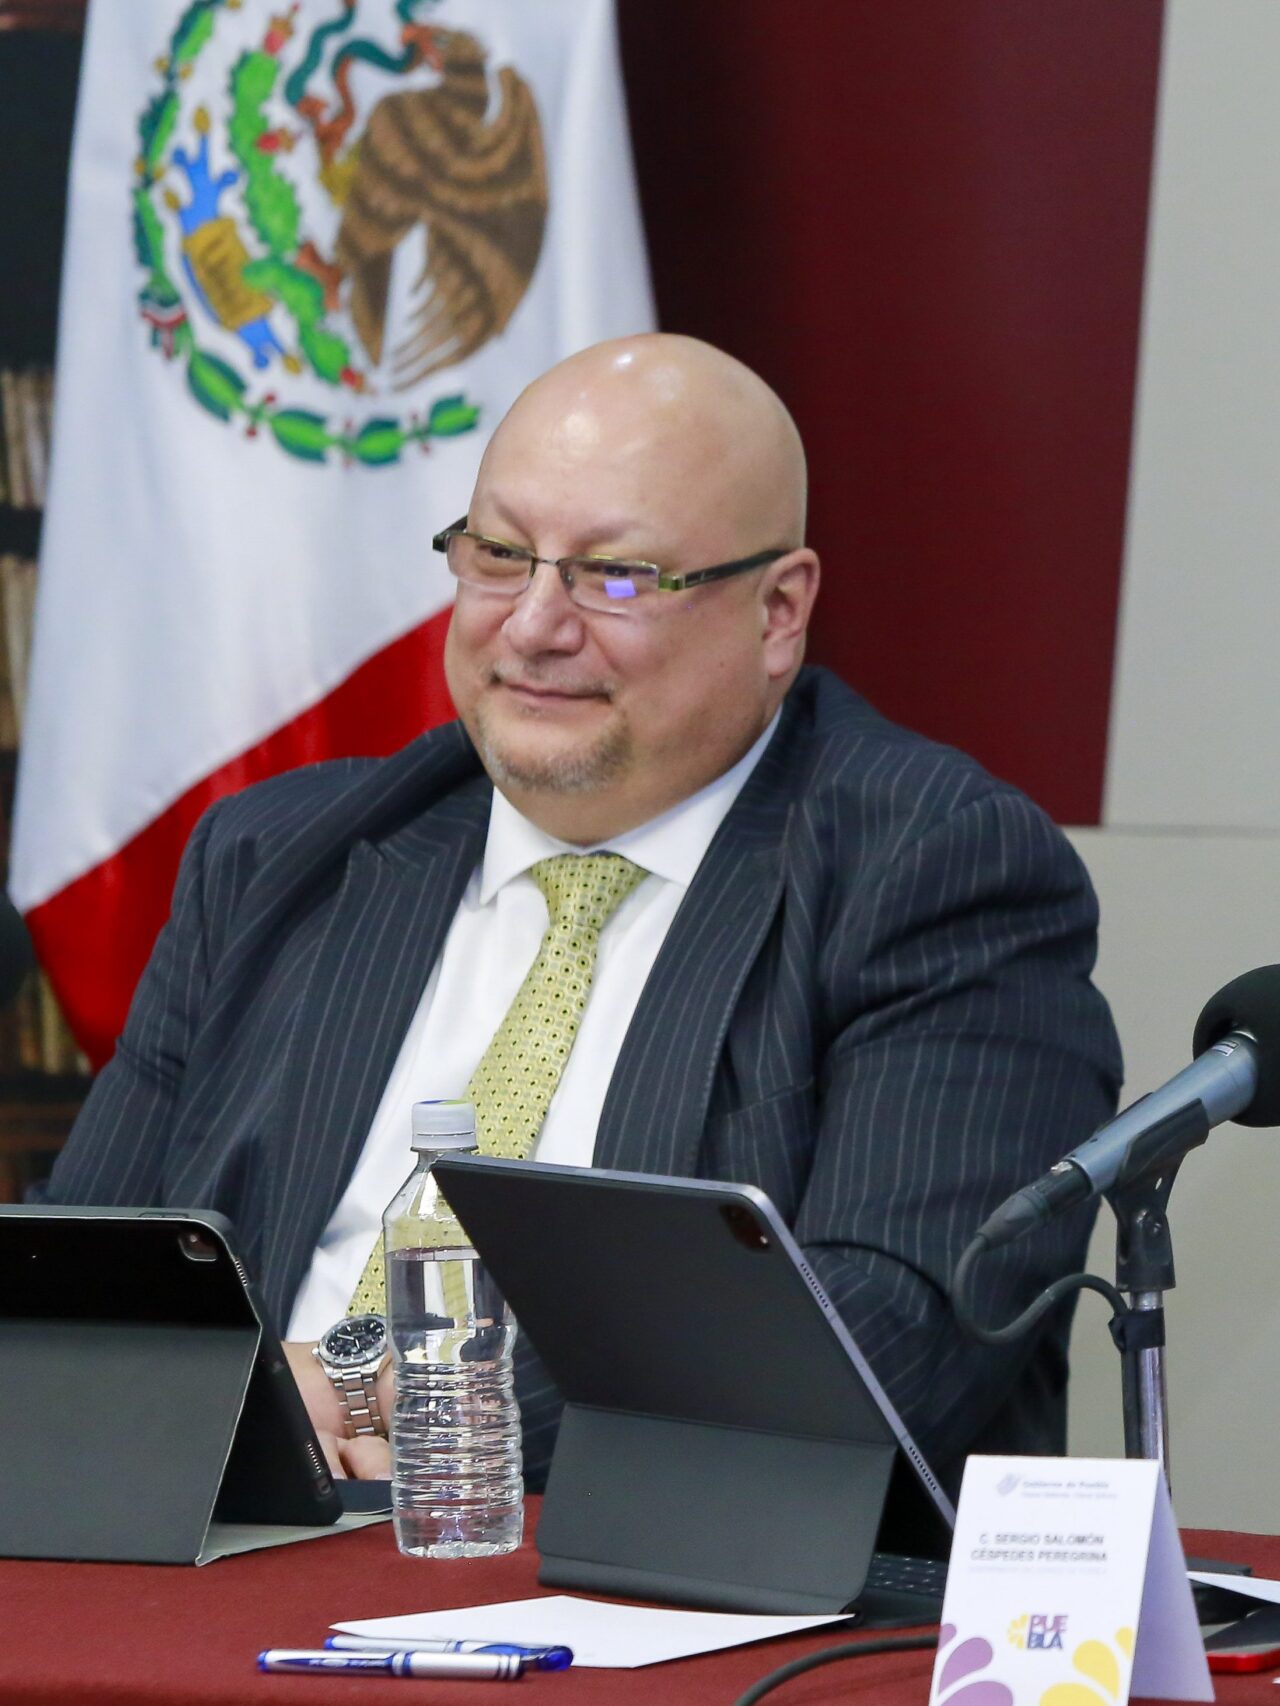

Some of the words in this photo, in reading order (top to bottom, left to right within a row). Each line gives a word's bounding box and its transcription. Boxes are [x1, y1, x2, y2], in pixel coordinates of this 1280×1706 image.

[994, 1534, 1040, 1545] SERGIO
[1043, 1532, 1104, 1545] SALOMÓN
[971, 1547, 1035, 1561] CÉSPEDES
[1038, 1550, 1108, 1562] PEREGRINA
